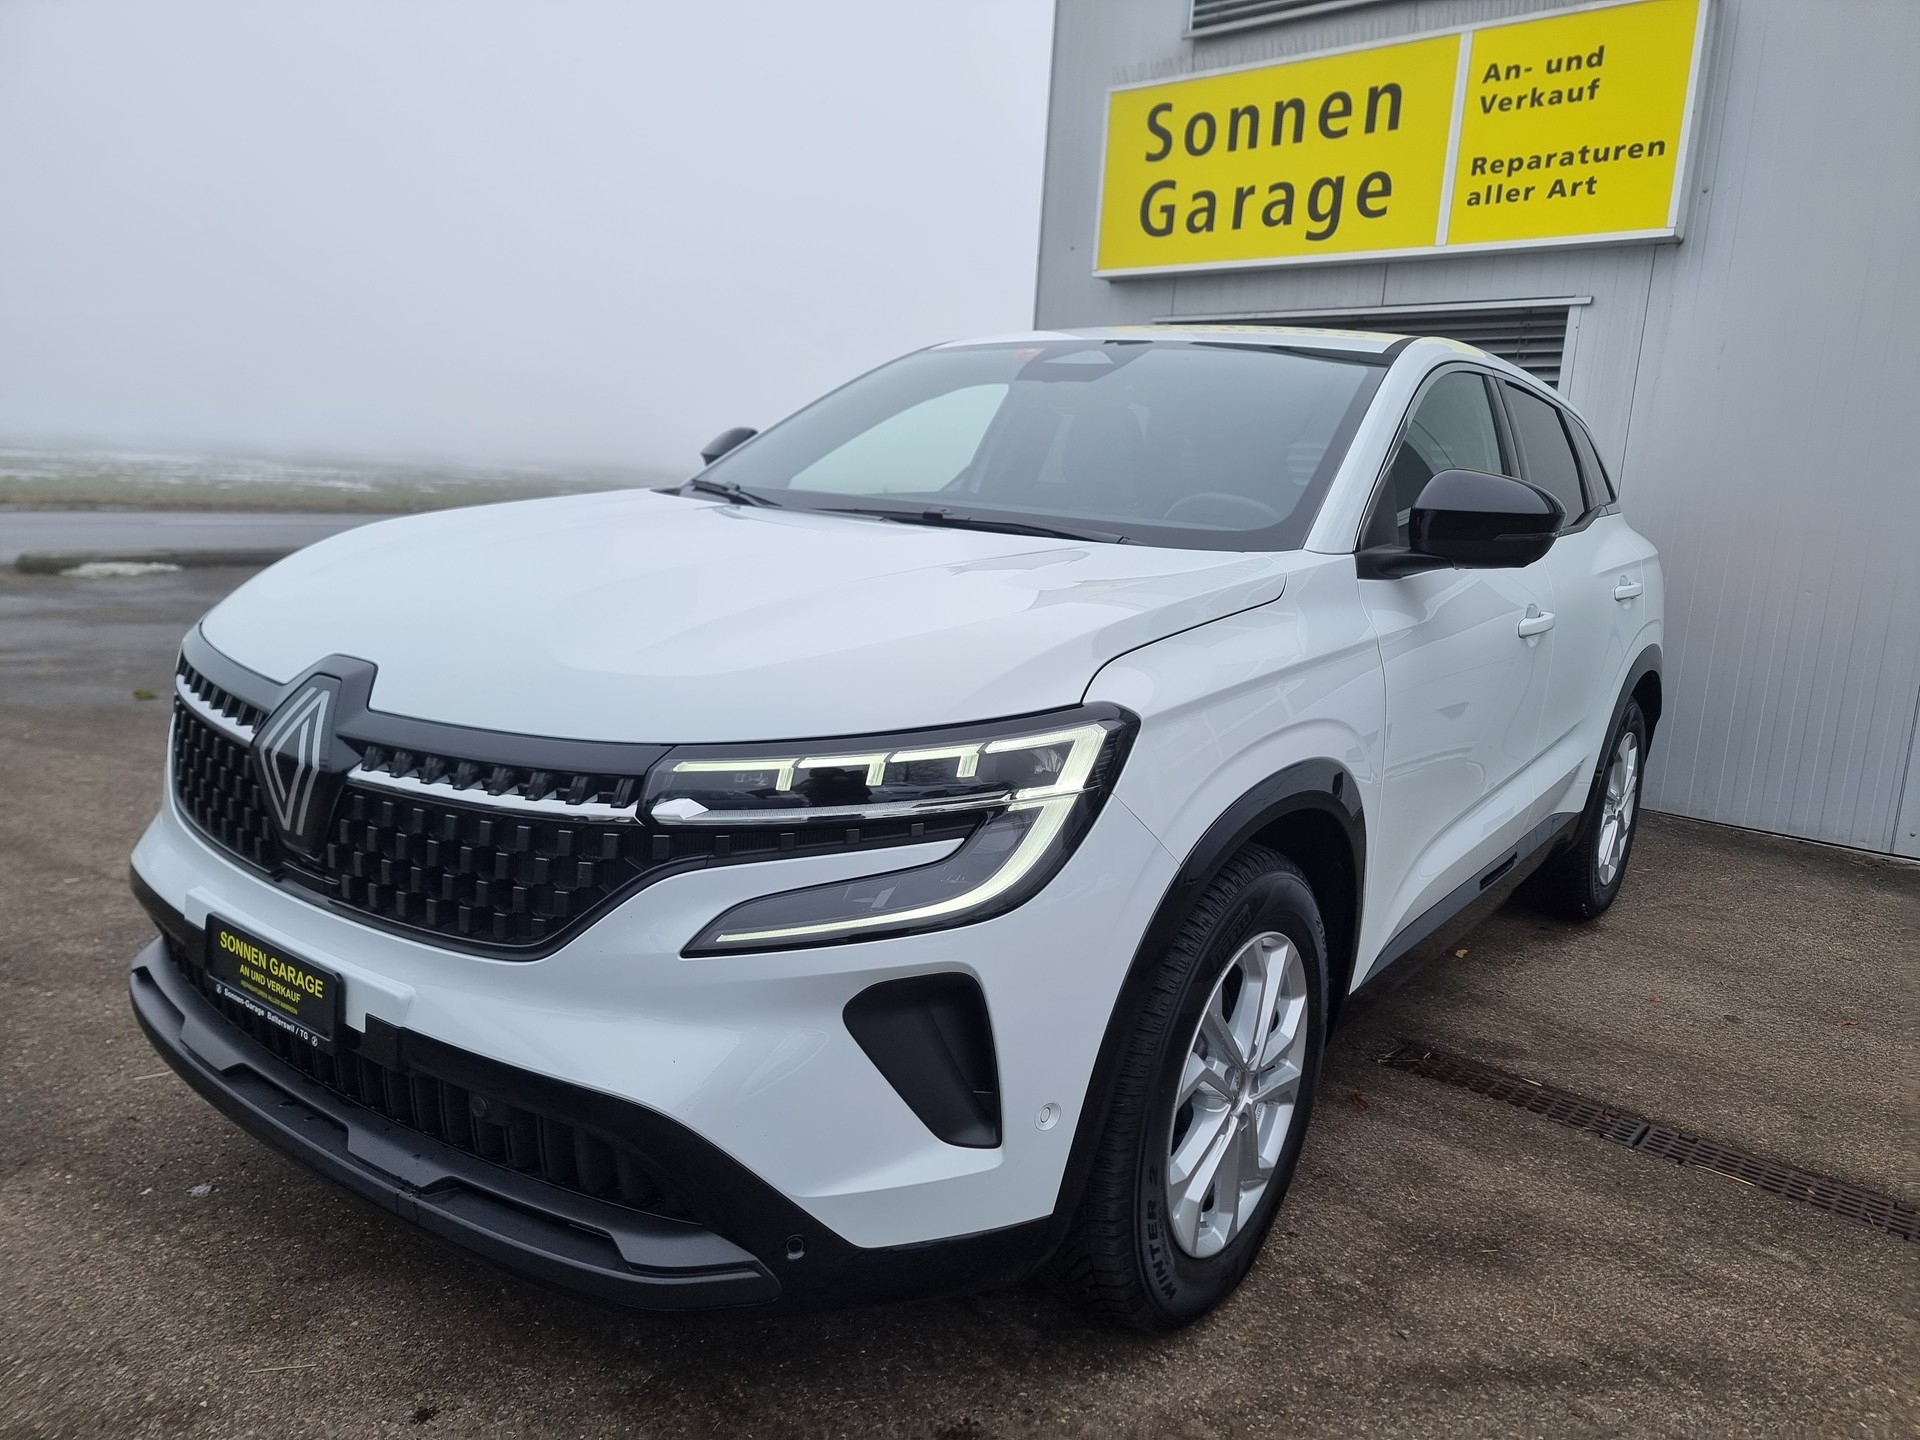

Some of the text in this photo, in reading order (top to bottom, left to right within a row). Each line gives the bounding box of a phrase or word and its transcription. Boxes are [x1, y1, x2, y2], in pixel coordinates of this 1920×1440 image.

[1483, 45, 1606, 83] An- und
[1480, 79, 1601, 115] Verkauf
[1145, 80, 1404, 162] Sonnen
[1470, 138, 1666, 178] Reparaturen
[1139, 168, 1393, 242] Garage
[1466, 174, 1598, 207] aller Art
[219, 930, 267, 970] SONNEN
[269, 957, 324, 999] GARAGE
[239, 964, 250, 978] AN
[250, 971, 266, 986] UND
[266, 978, 301, 1004] VERKAUF
[1147, 1200, 1178, 1300] WINTER
